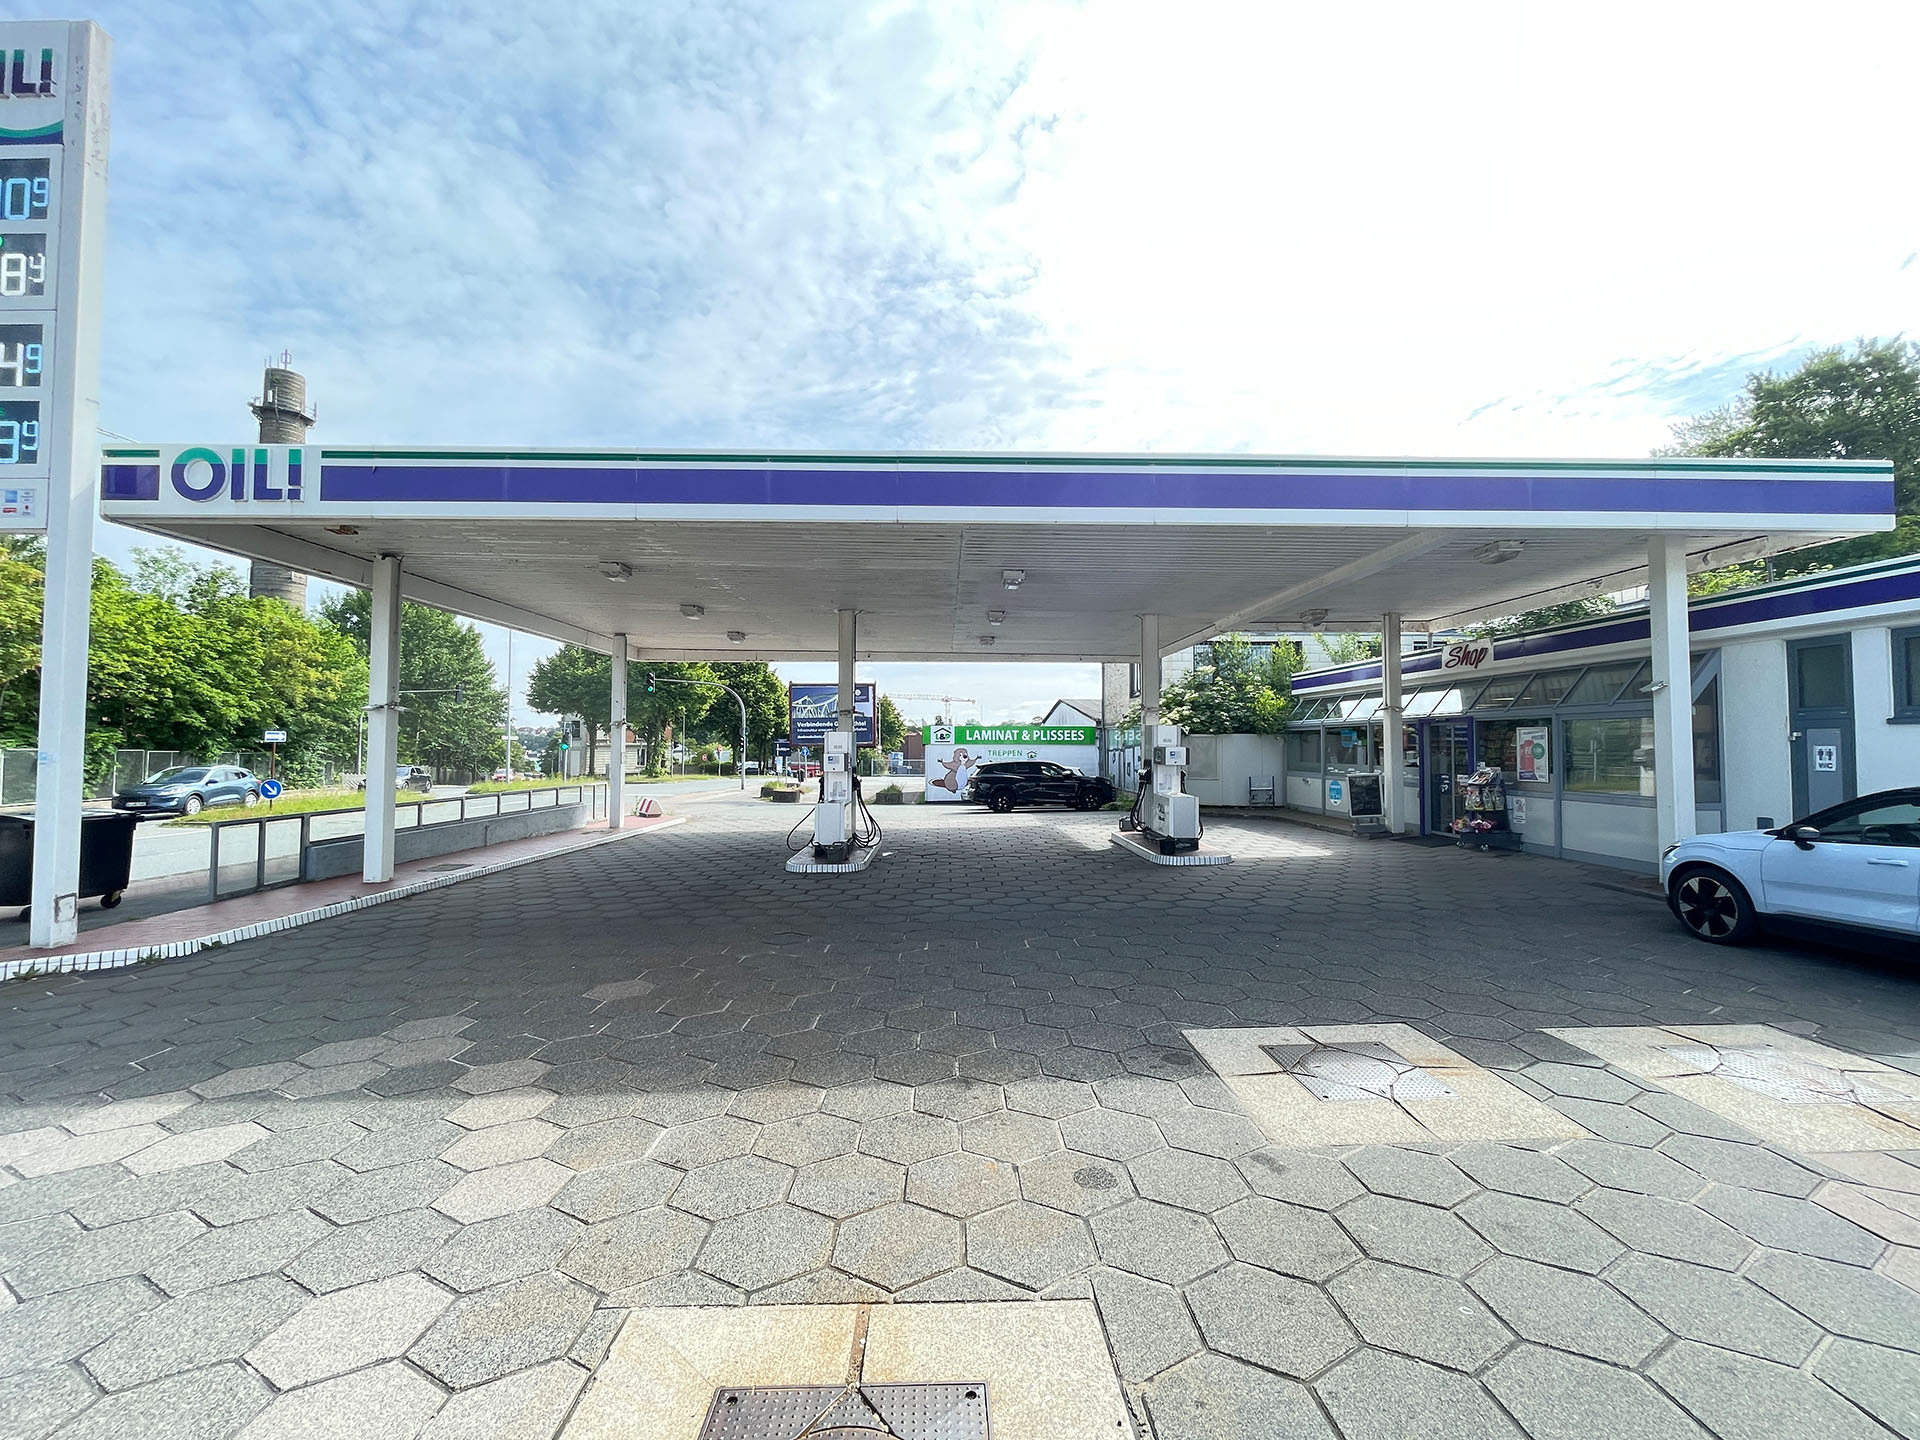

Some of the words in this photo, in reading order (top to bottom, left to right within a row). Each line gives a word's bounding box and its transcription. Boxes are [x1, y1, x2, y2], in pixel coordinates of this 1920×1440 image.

[0, 177, 49, 220] 09
[171, 447, 302, 502] OIL!
[1445, 644, 1488, 669] Shop
[966, 729, 1019, 741] LAMINAT
[1022, 729, 1031, 741] &
[1033, 729, 1085, 741] PLISSEES
